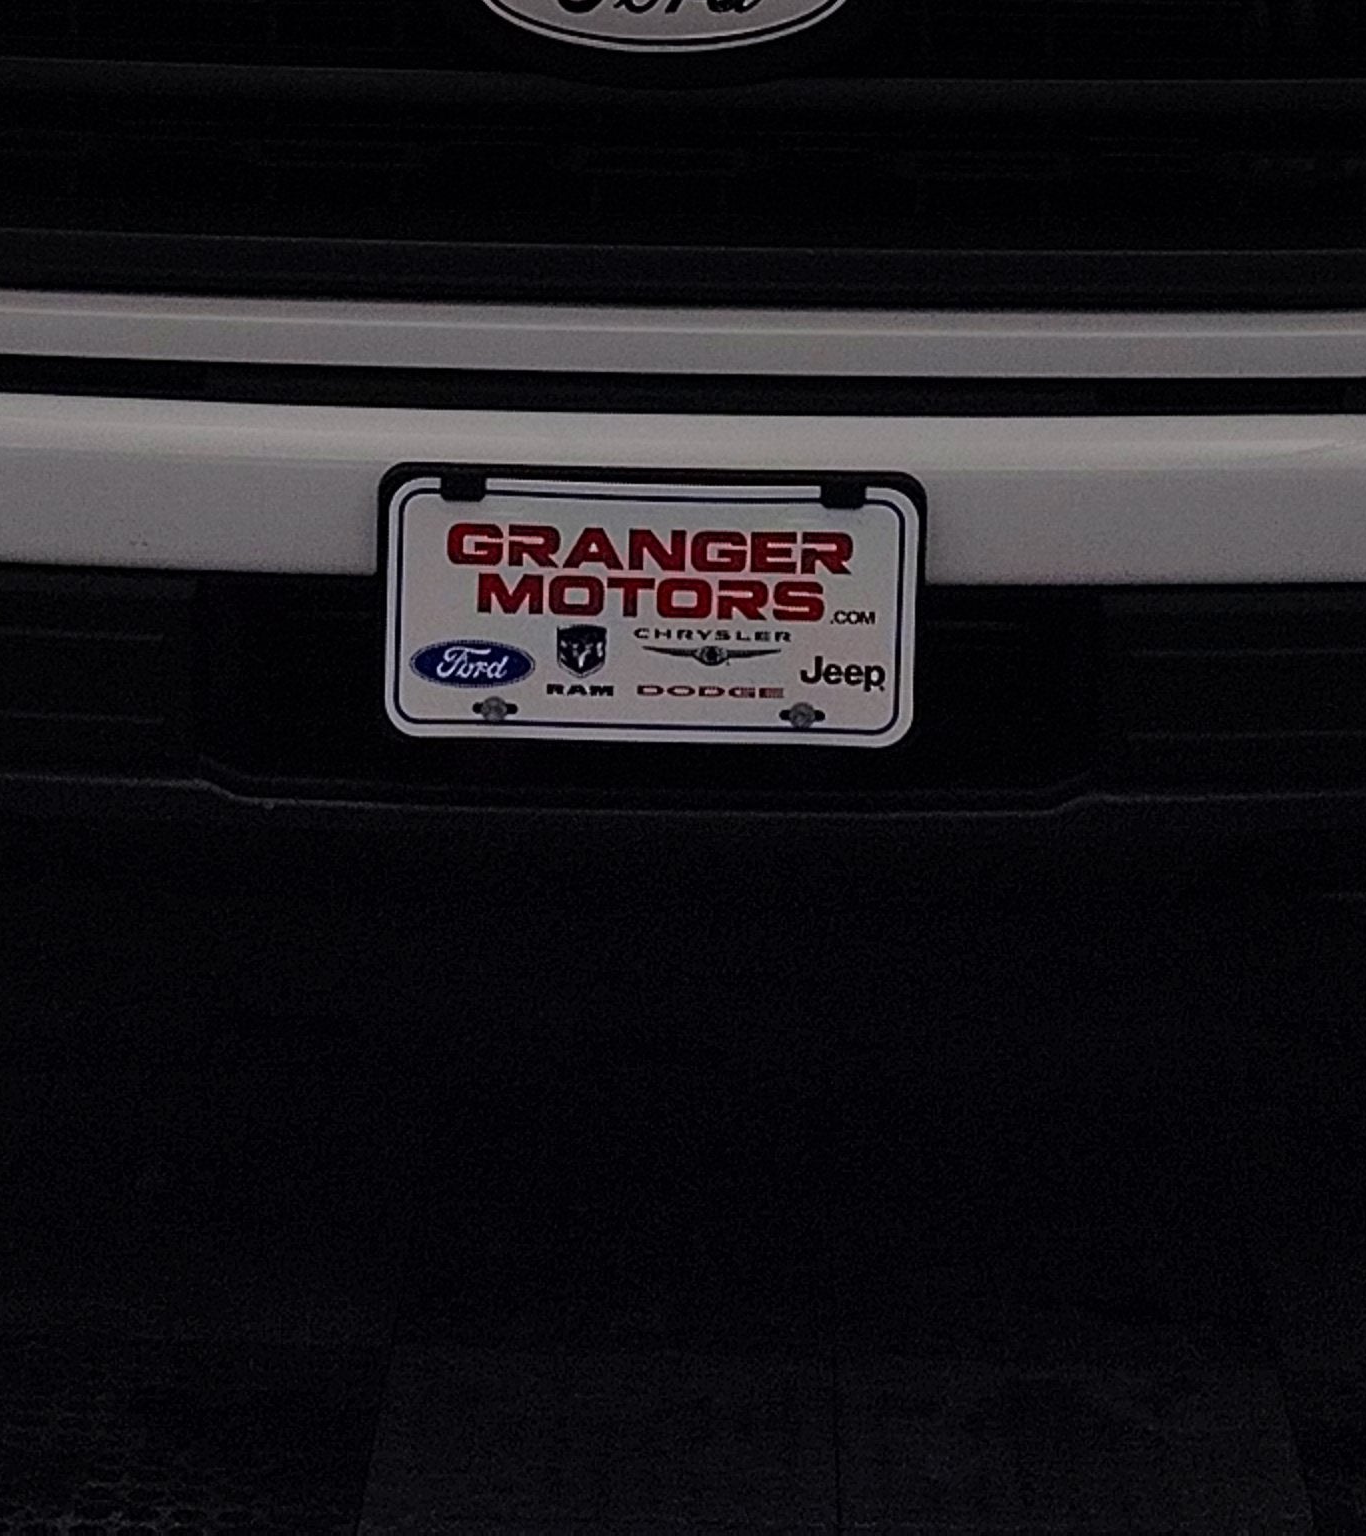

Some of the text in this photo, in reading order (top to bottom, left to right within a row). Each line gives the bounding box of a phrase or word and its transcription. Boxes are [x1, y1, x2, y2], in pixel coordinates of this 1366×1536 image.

[447, 522, 854, 576] GRANGER
[477, 572, 877, 626] MOTORS .COM
[633, 627, 792, 643] CHRYSLER
[436, 645, 510, 679] Ford
[800, 655, 886, 693] Jeep
[546, 683, 615, 697] RAM
[636, 684, 786, 700] DODGE
